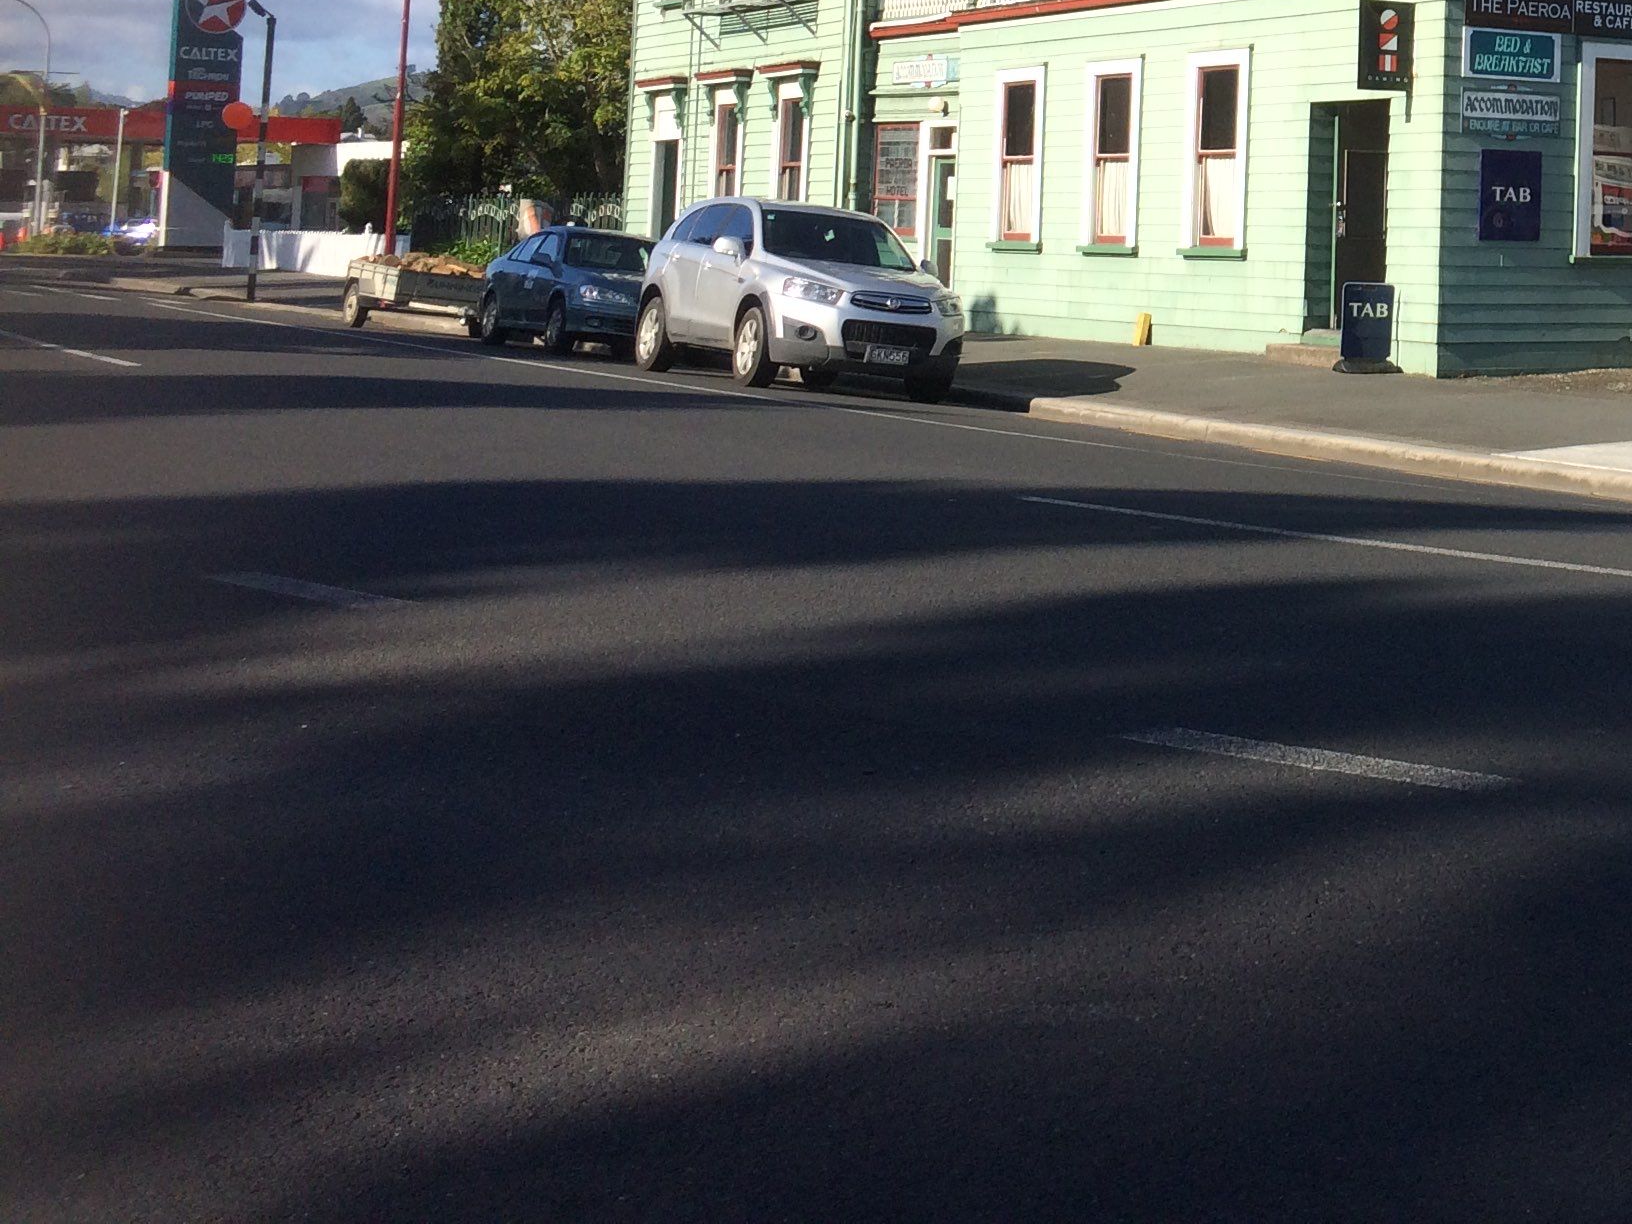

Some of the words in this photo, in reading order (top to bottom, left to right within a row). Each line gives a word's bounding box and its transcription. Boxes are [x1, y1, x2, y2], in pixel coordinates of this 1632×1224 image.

[1593, 15, 1602, 27] &
[1494, 35, 1520, 53] BED
[1523, 38, 1532, 54] &
[179, 46, 239, 62] CALTEX
[1474, 53, 1551, 75] BREAKFAST
[1367, 74, 1409, 84] GAMING
[1465, 95, 1559, 118] ACCOMMODATION
[1491, 186, 1532, 203] TAB
[1348, 302, 1389, 318] TAB
